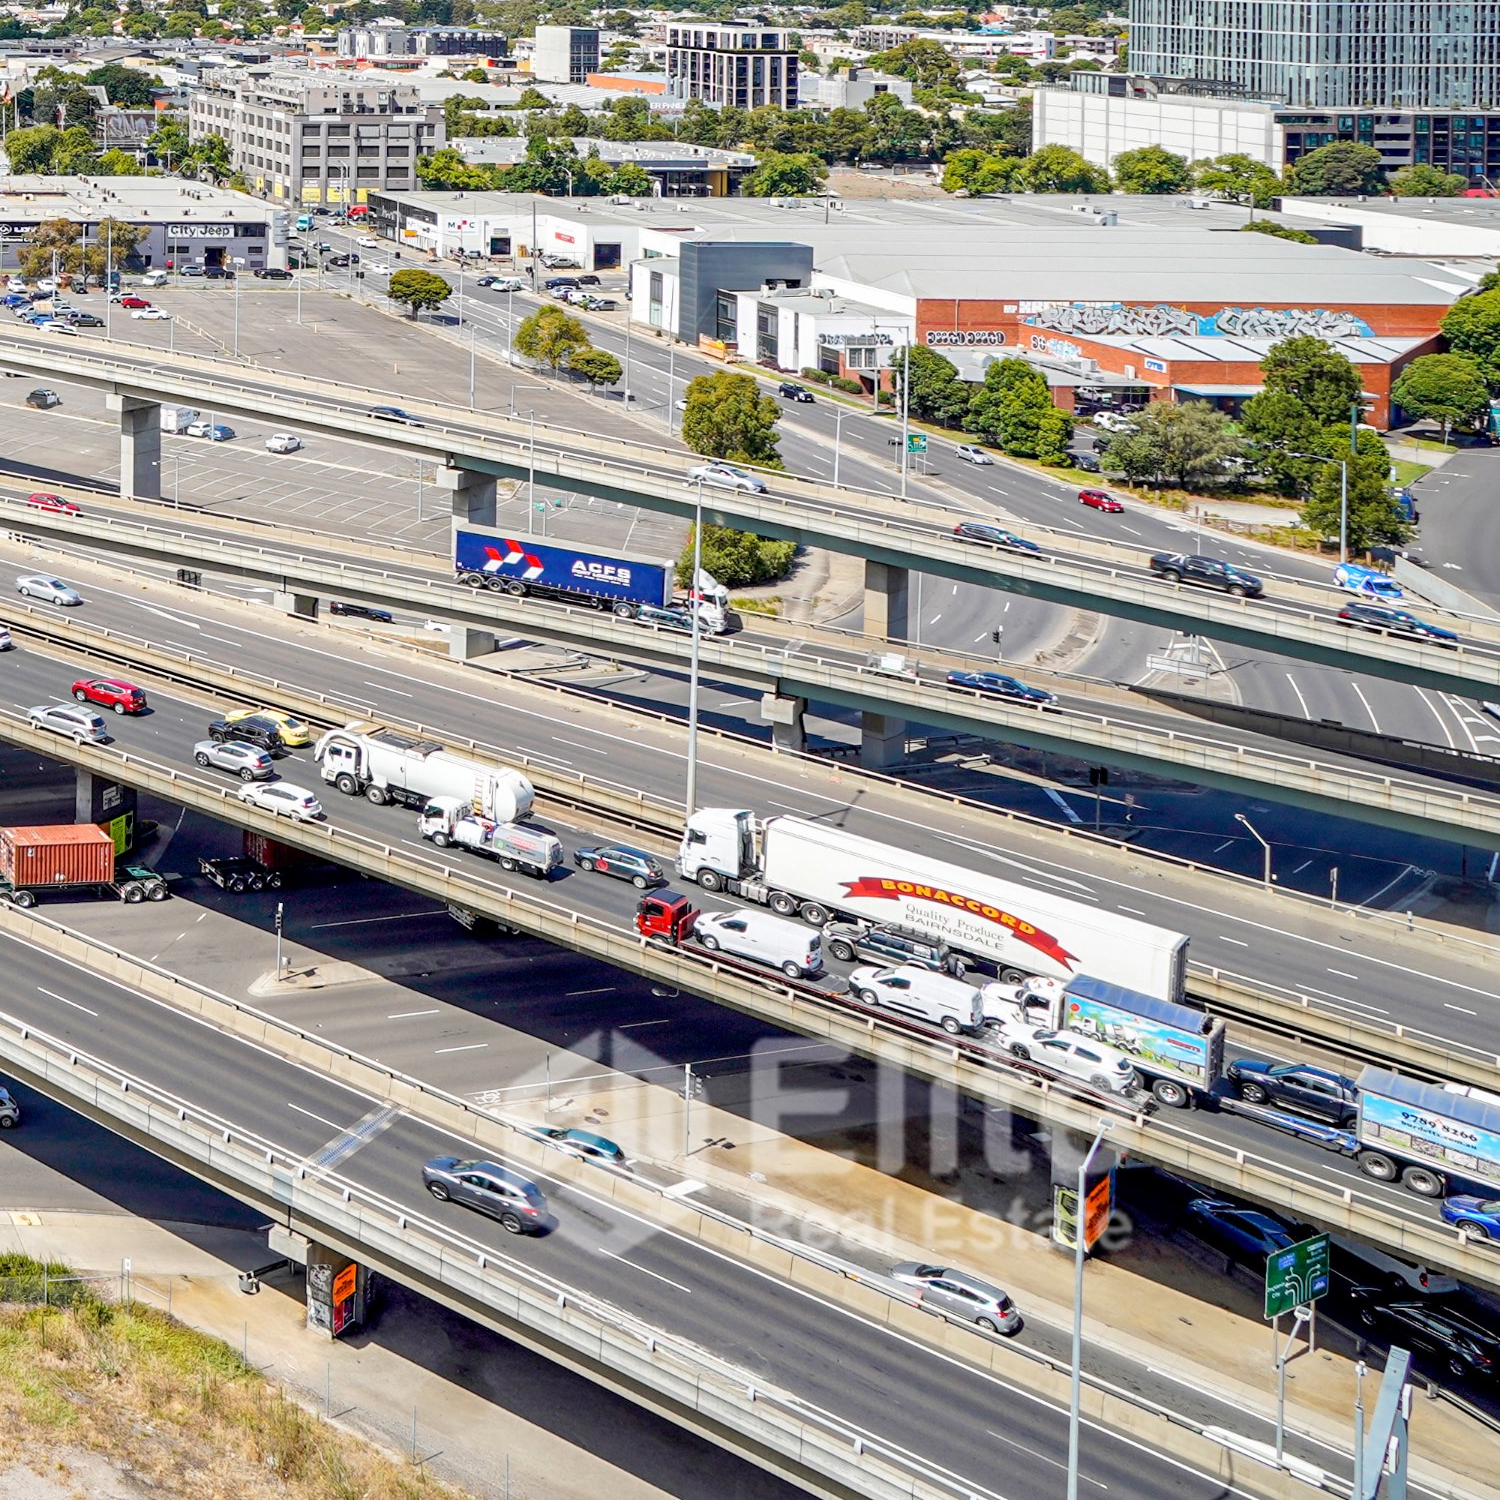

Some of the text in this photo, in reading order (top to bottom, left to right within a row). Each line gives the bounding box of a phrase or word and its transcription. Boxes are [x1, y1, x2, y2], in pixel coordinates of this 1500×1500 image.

[170, 224, 231, 238] City Jeep
[571, 559, 631, 579] ACFS
[880, 878, 1037, 935] BONACCORD
[906, 903, 1005, 941] Quality Produce
[905, 913, 1004, 950] BAIRNSDALE
[1401, 1111, 1478, 1142] 9789 8266
